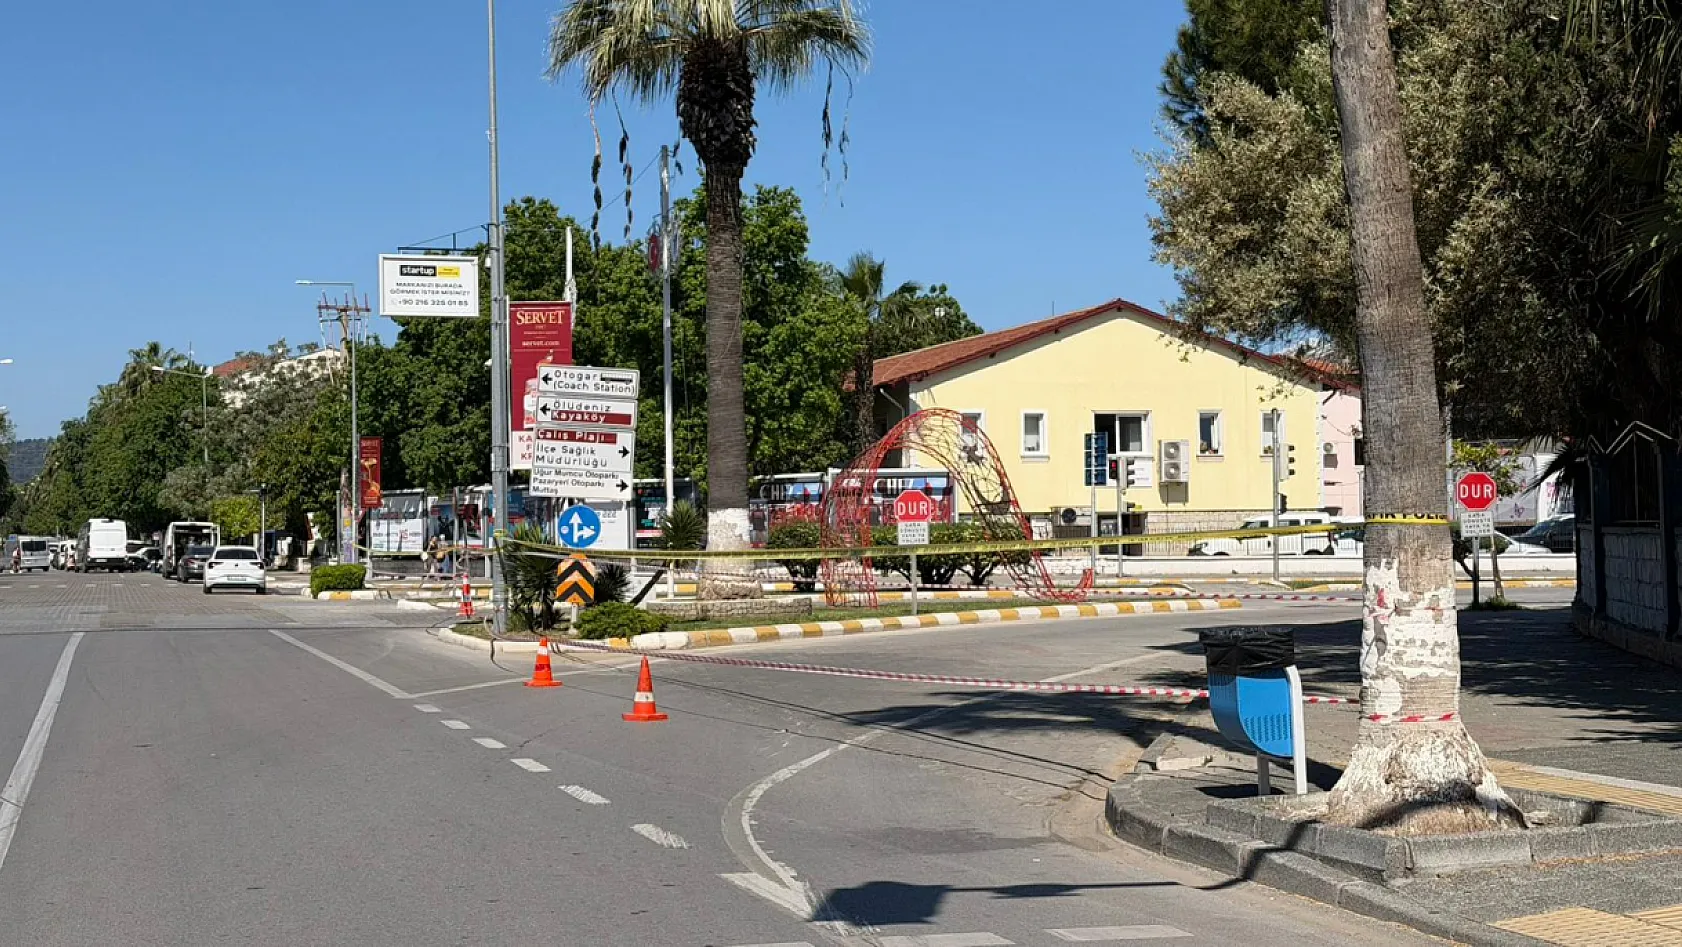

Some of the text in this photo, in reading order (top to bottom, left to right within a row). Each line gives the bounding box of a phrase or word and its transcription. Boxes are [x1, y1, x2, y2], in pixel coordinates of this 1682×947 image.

[401, 265, 435, 276] startup
[516, 310, 565, 325] SERVET
[554, 369, 598, 381] Otogar
[553, 380, 635, 394] (Coach Station)
[553, 399, 612, 412] Ölüdeniz
[552, 411, 606, 422] Kayaköy
[575, 431, 605, 443] Plajı
[536, 442, 557, 454] İlçe
[561, 445, 597, 456] Sağlık
[535, 454, 608, 468] Müdürlüğü
[534, 467, 620, 480] Uğur Mumcu Otoparkı
[532, 477, 605, 488] Pazaryeri Otoparkı
[1460, 483, 1493, 499] DUR
[897, 501, 928, 516] DUR
